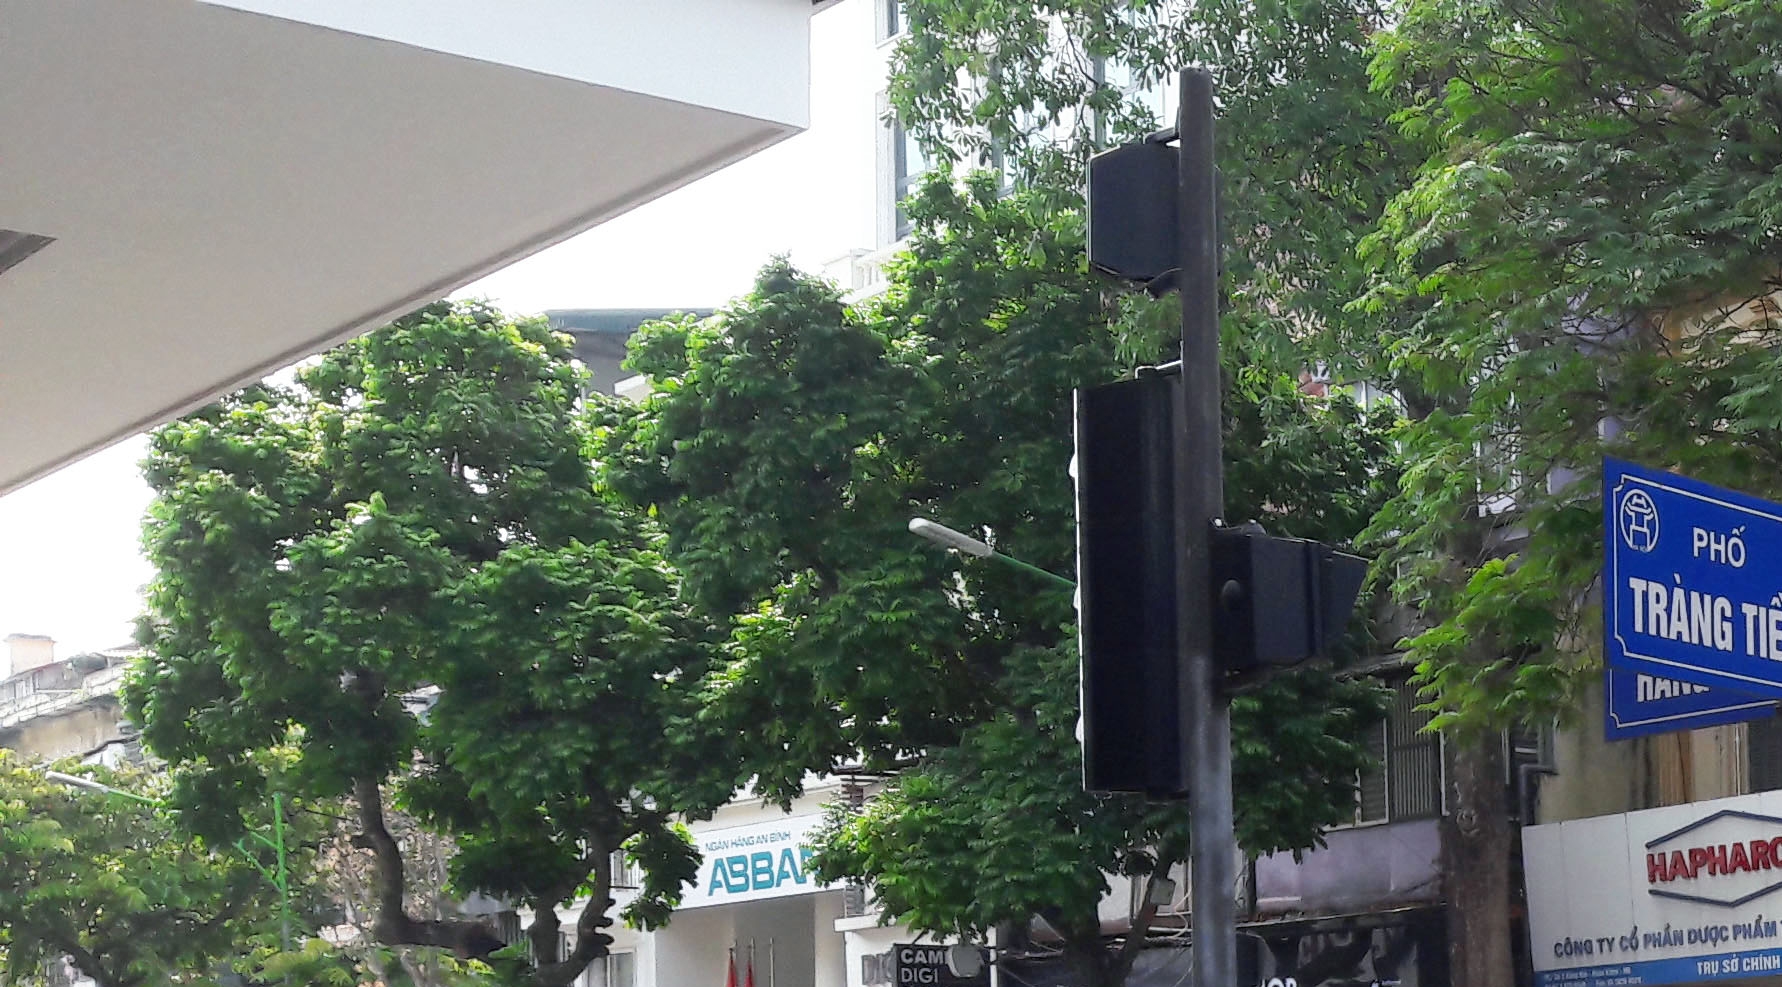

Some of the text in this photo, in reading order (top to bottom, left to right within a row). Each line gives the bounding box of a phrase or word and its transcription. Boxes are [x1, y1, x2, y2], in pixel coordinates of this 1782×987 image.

[1693, 525, 1746, 568] PHỐ
[1629, 572, 1733, 652] TRÀNG
[900, 948, 944, 965] CAM
[1553, 936, 1594, 959] CÔNG
[1596, 936, 1615, 953] TY
[1687, 925, 1730, 947] DƯỢC
[1732, 914, 1777, 942] PHẨM
[1697, 953, 1781, 976] TRỤ SỞ CHÍNH
